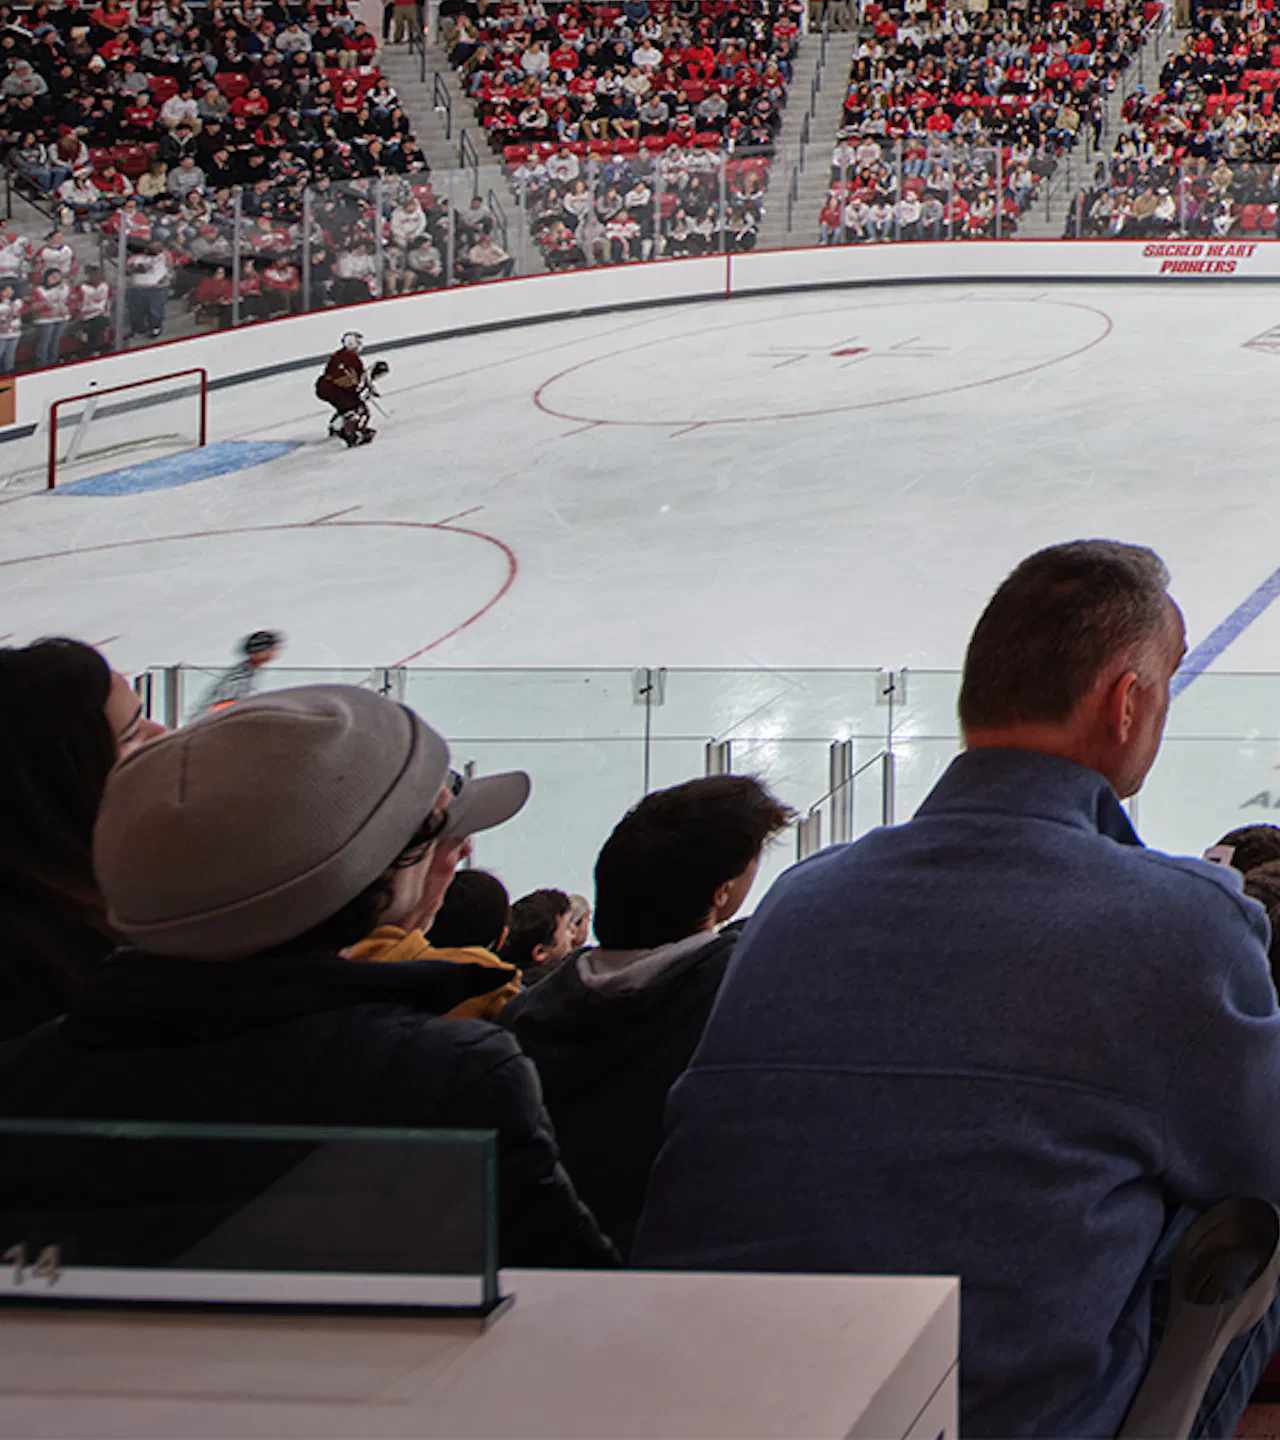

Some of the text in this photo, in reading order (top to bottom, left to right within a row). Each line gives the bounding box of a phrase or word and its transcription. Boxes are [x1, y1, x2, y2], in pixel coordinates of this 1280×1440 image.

[1143, 244, 1257, 257] SACRED HEART
[1160, 260, 1237, 273] PIONEERS
